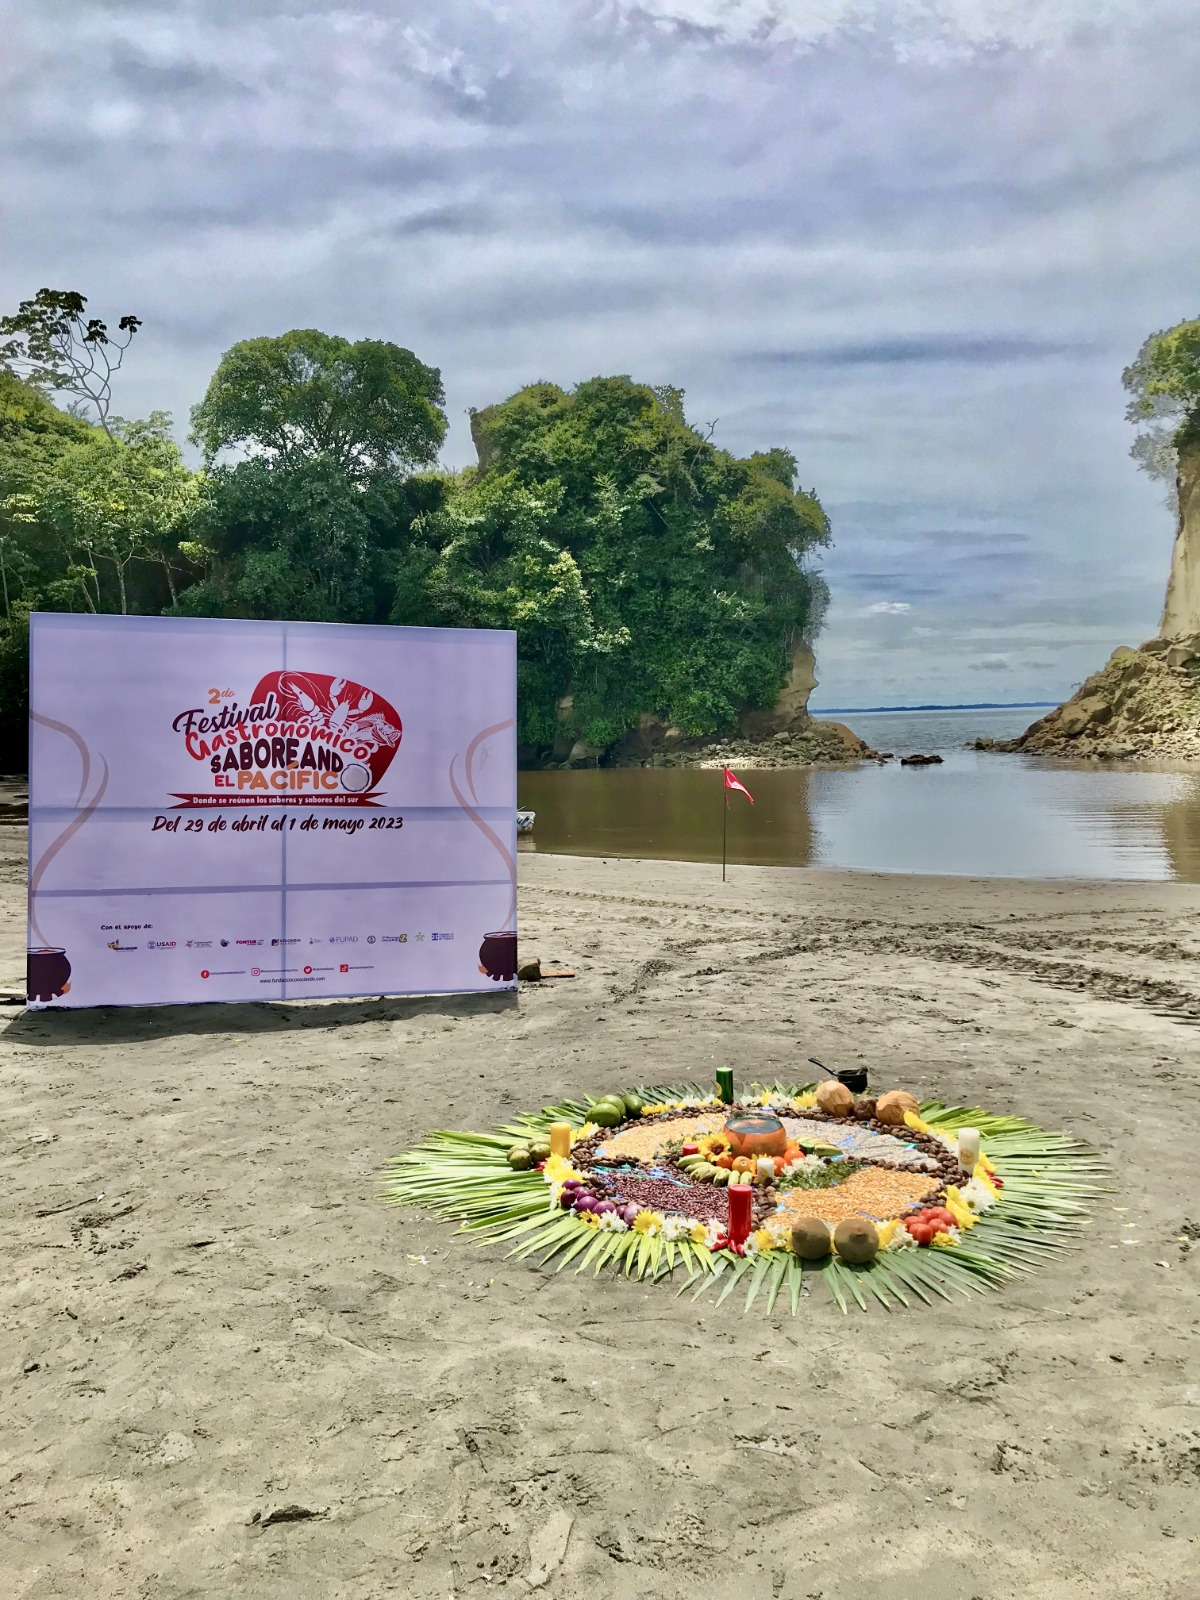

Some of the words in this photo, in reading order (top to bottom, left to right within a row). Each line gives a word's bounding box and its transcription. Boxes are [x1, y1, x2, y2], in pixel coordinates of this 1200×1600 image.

[172, 694, 278, 736] Festival
[185, 721, 370, 762] Gastronómico
[214, 774, 235, 787] EL
[192, 796, 217, 804] Donde
[228, 796, 255, 804] reúnen
[256, 795, 267, 804] los
[298, 797, 303, 805] y
[304, 795, 333, 804] sabores
[334, 795, 346, 803] del
[151, 815, 181, 833] Del
[184, 818, 204, 833] 29
[207, 814, 227, 833] de
[231, 814, 269, 832] abril
[270, 813, 287, 831] al
[289, 817, 297, 831] 1
[299, 813, 319, 831] de
[322, 817, 365, 835] mayo
[368, 816, 404, 830] 2023
[123, 923, 142, 931] apoyo
[335, 936, 359, 944] FUPAD
